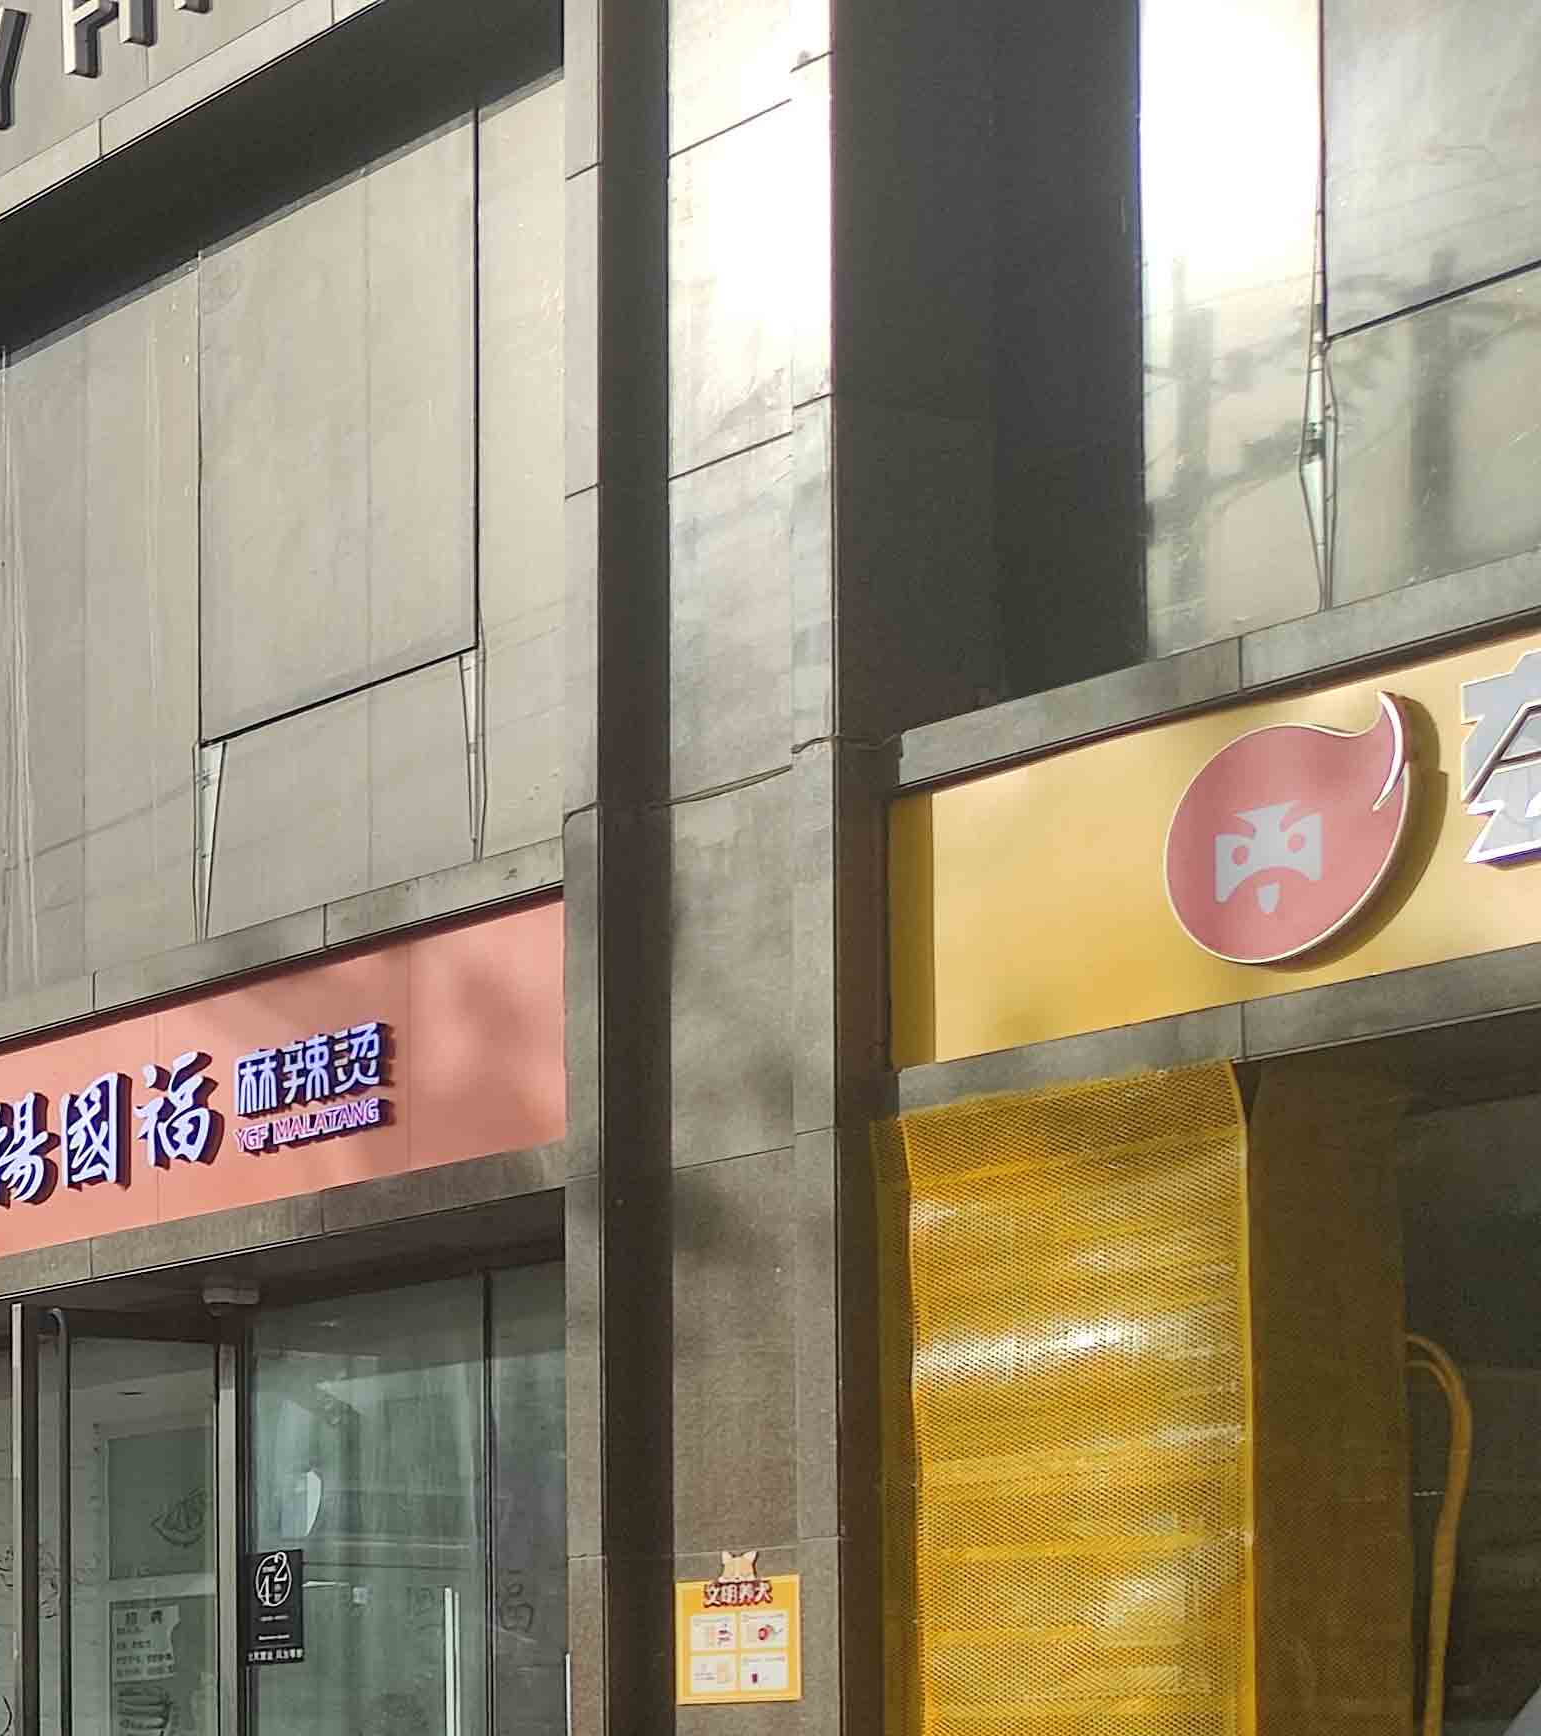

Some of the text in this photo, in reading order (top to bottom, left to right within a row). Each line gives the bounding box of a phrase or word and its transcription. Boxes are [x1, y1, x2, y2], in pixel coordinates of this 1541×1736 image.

[234, 1022, 380, 1115] 麻辣烫
[235, 1098, 380, 1152] YGF MALATANG
[705, 1581, 773, 1606] 文明养犬
